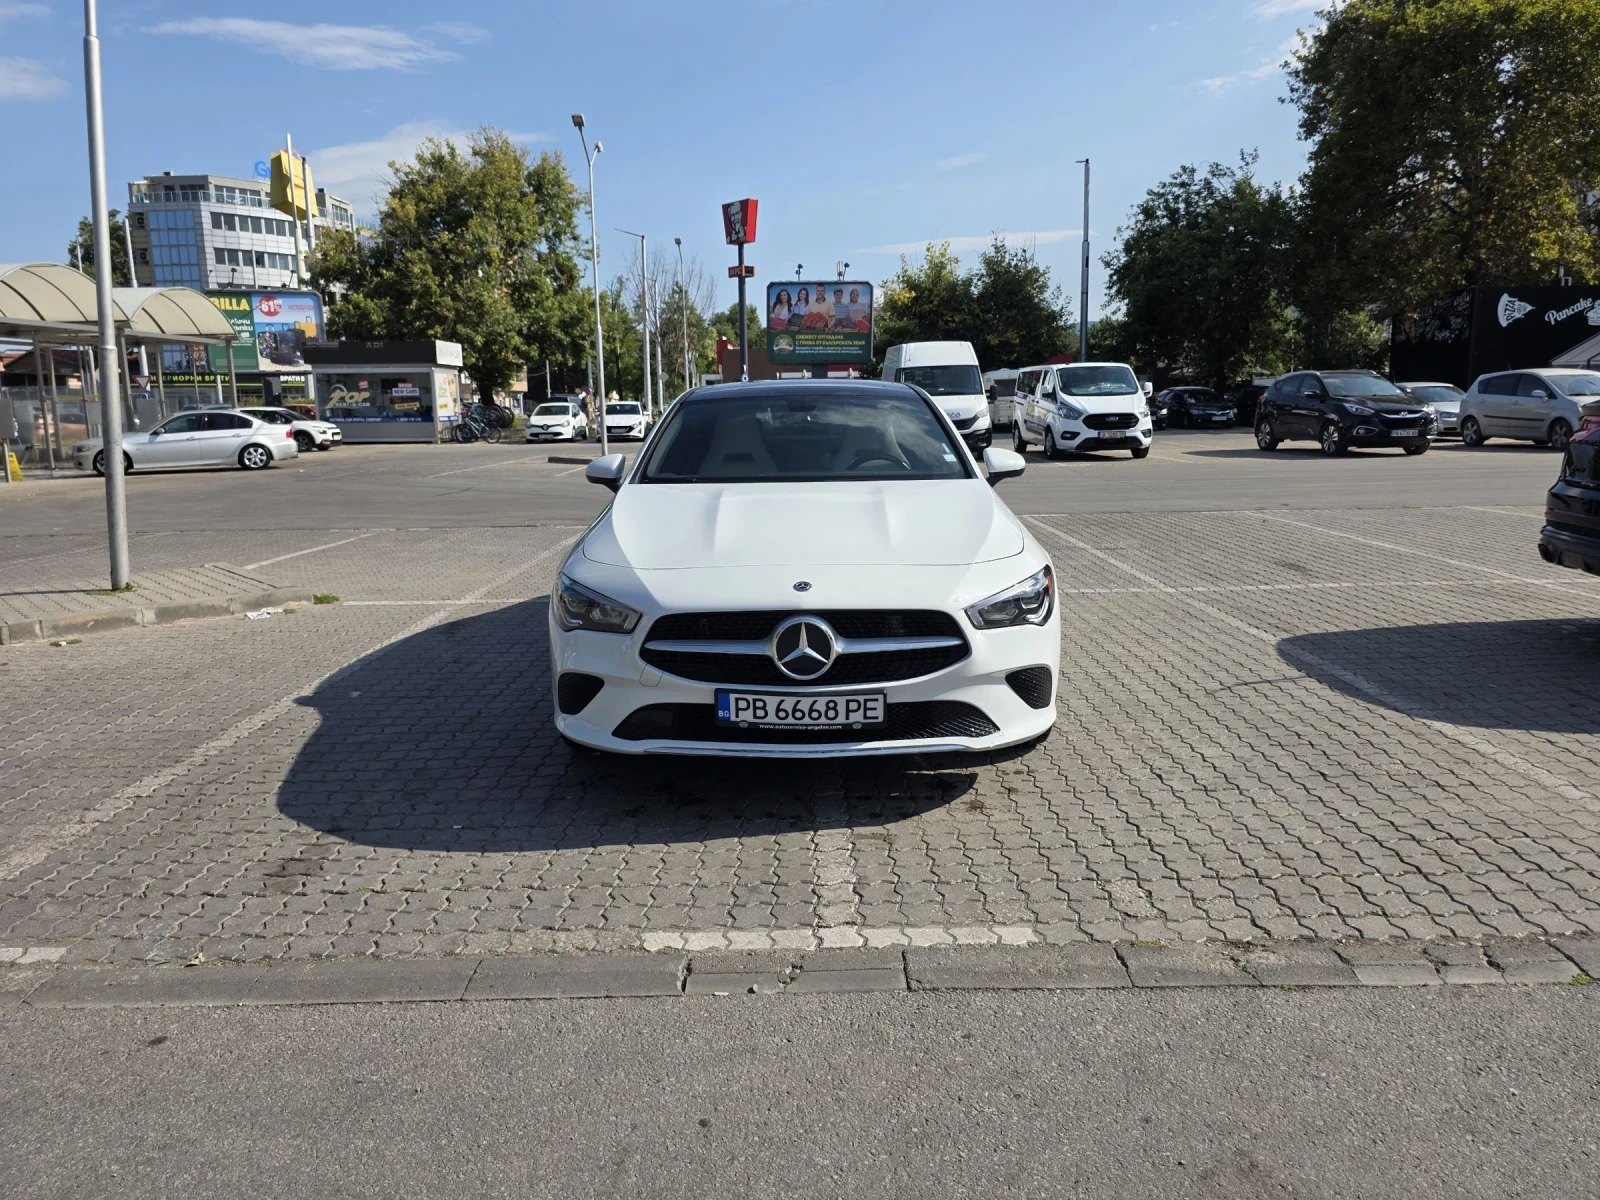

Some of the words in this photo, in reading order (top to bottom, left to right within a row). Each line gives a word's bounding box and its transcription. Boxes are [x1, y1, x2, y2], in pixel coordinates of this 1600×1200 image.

[729, 268, 742, 276] KFC
[1544, 297, 1594, 325] Pancake
[325, 391, 370, 408] TOP
[718, 710, 730, 718] BG
[734, 697, 769, 720] PB
[775, 698, 839, 721] 6668
[845, 698, 879, 720] PE
